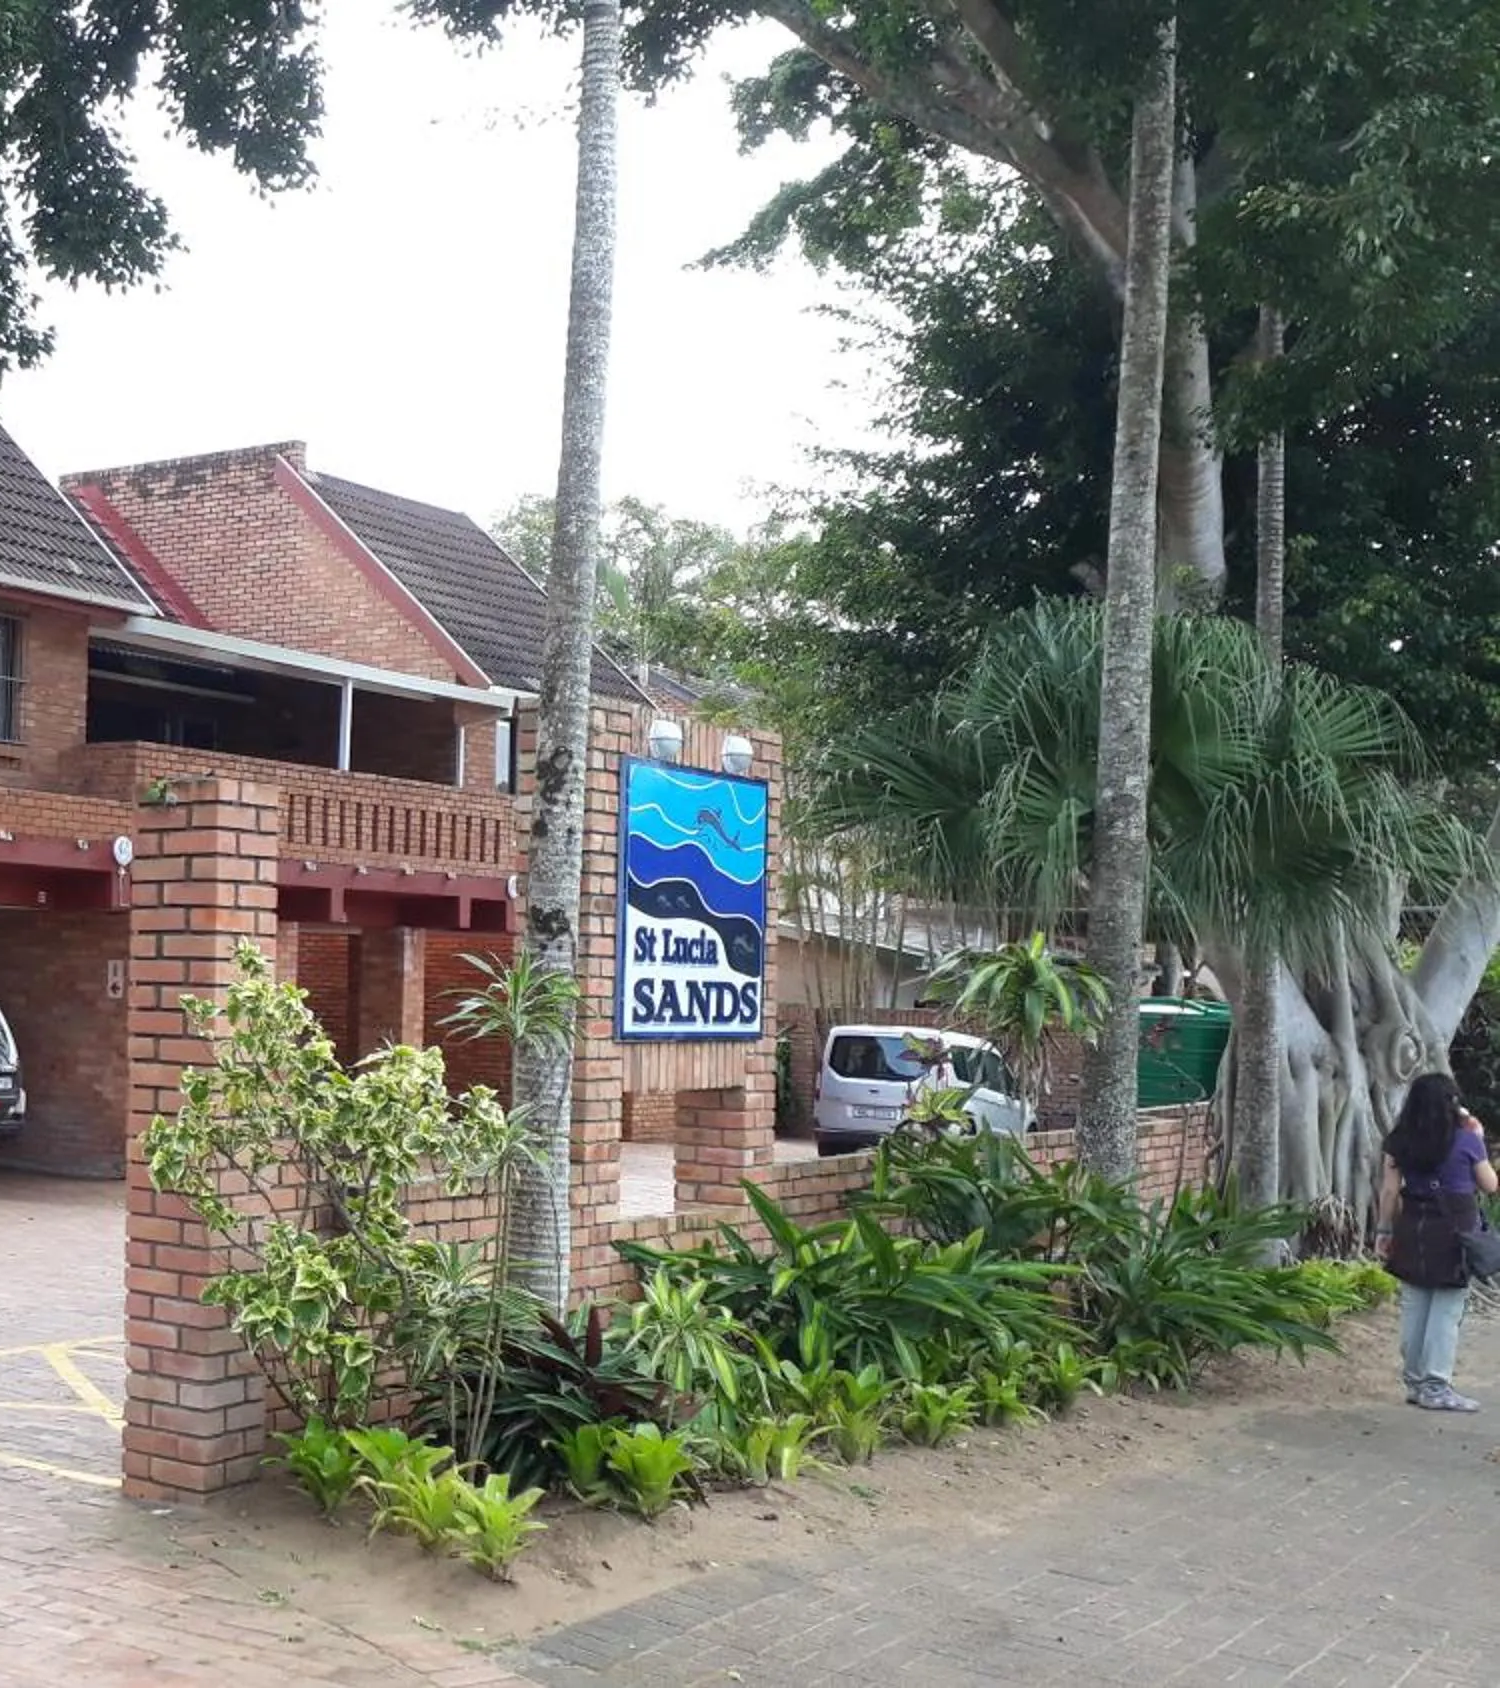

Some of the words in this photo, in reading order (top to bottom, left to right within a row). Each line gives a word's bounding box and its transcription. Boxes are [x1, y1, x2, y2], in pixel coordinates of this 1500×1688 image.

[634, 926, 657, 963] St
[662, 928, 719, 965] Lucia
[632, 978, 758, 1025] SANDS
